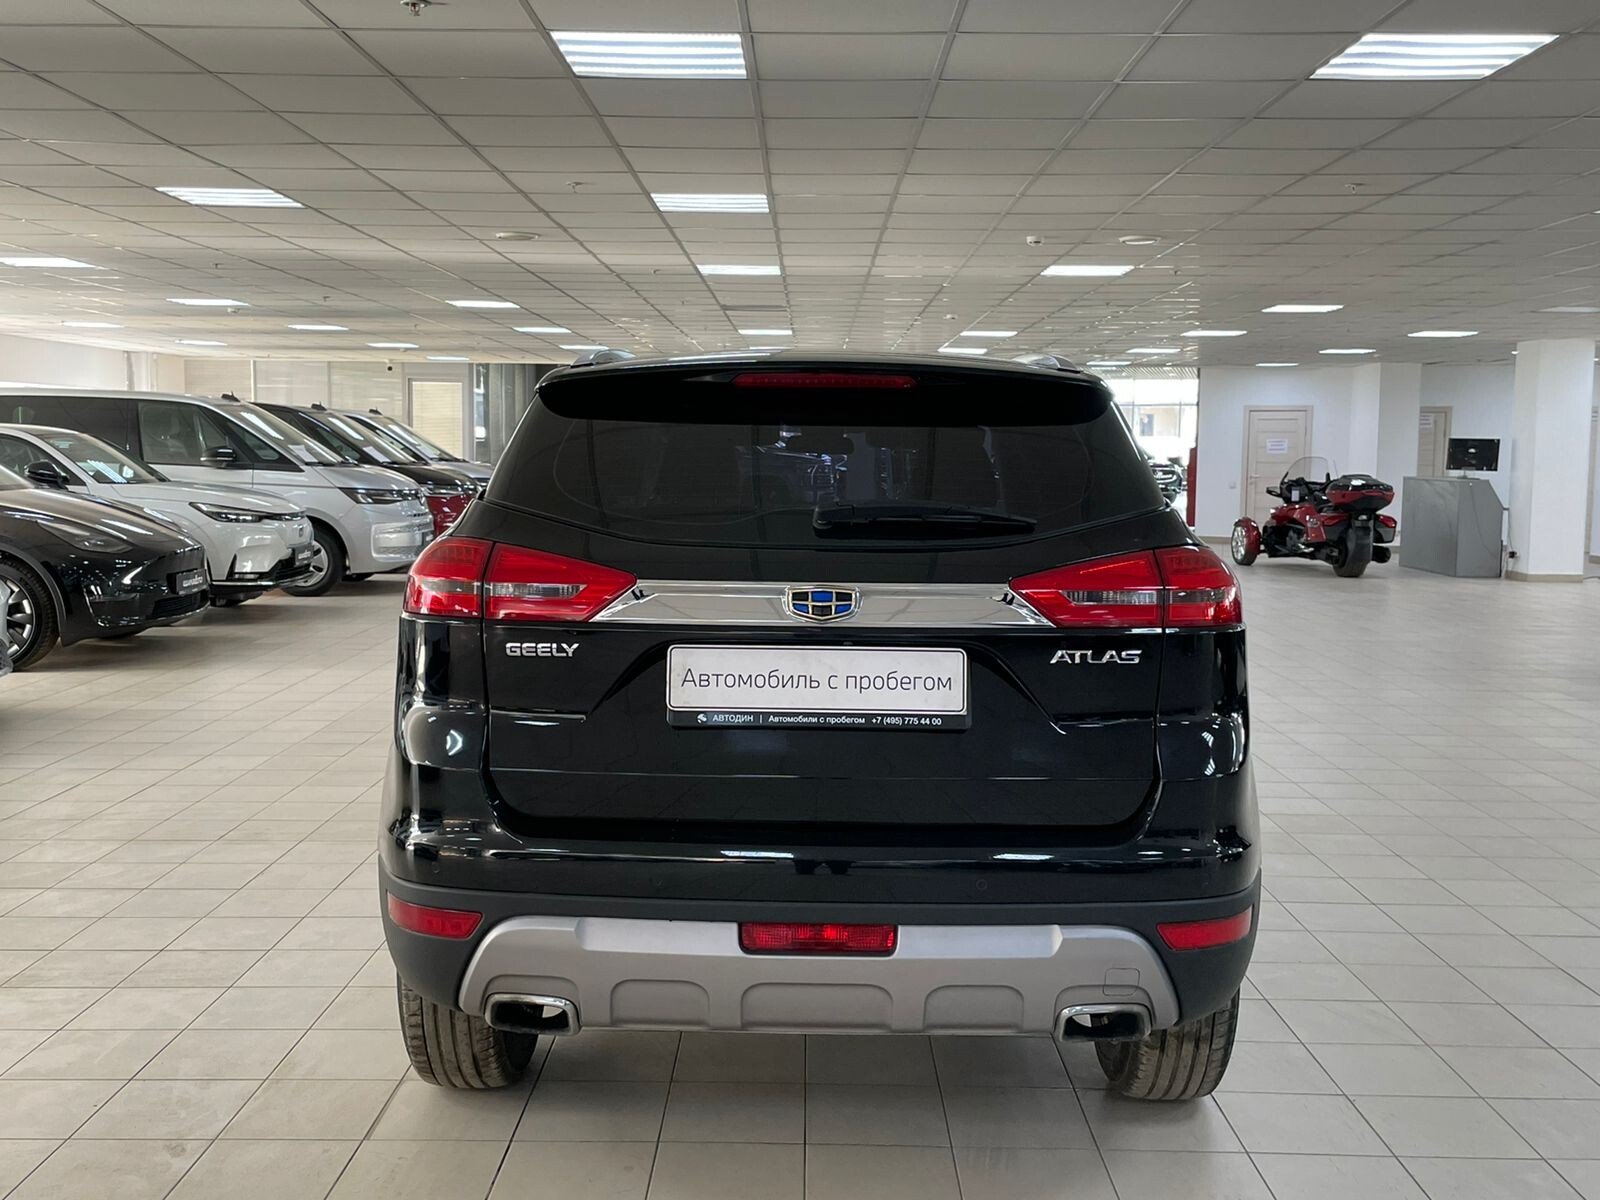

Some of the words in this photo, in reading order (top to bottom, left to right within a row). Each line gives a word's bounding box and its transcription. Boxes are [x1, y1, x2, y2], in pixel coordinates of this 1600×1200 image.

[505, 642, 579, 657] GEELY
[1049, 649, 1142, 664] ATLAS
[681, 668, 820, 689] Автомобиль
[827, 674, 838, 689] с
[845, 670, 952, 694] пробегом
[712, 714, 754, 723] АВТОДИН
[768, 714, 818, 724] Автомобили
[826, 715, 866, 725] пробегом
[871, 716, 882, 725] +7
[883, 716, 903, 726] (495)
[904, 716, 919, 726] 775
[920, 717, 930, 726] 44
[931, 717, 942, 726] 00
